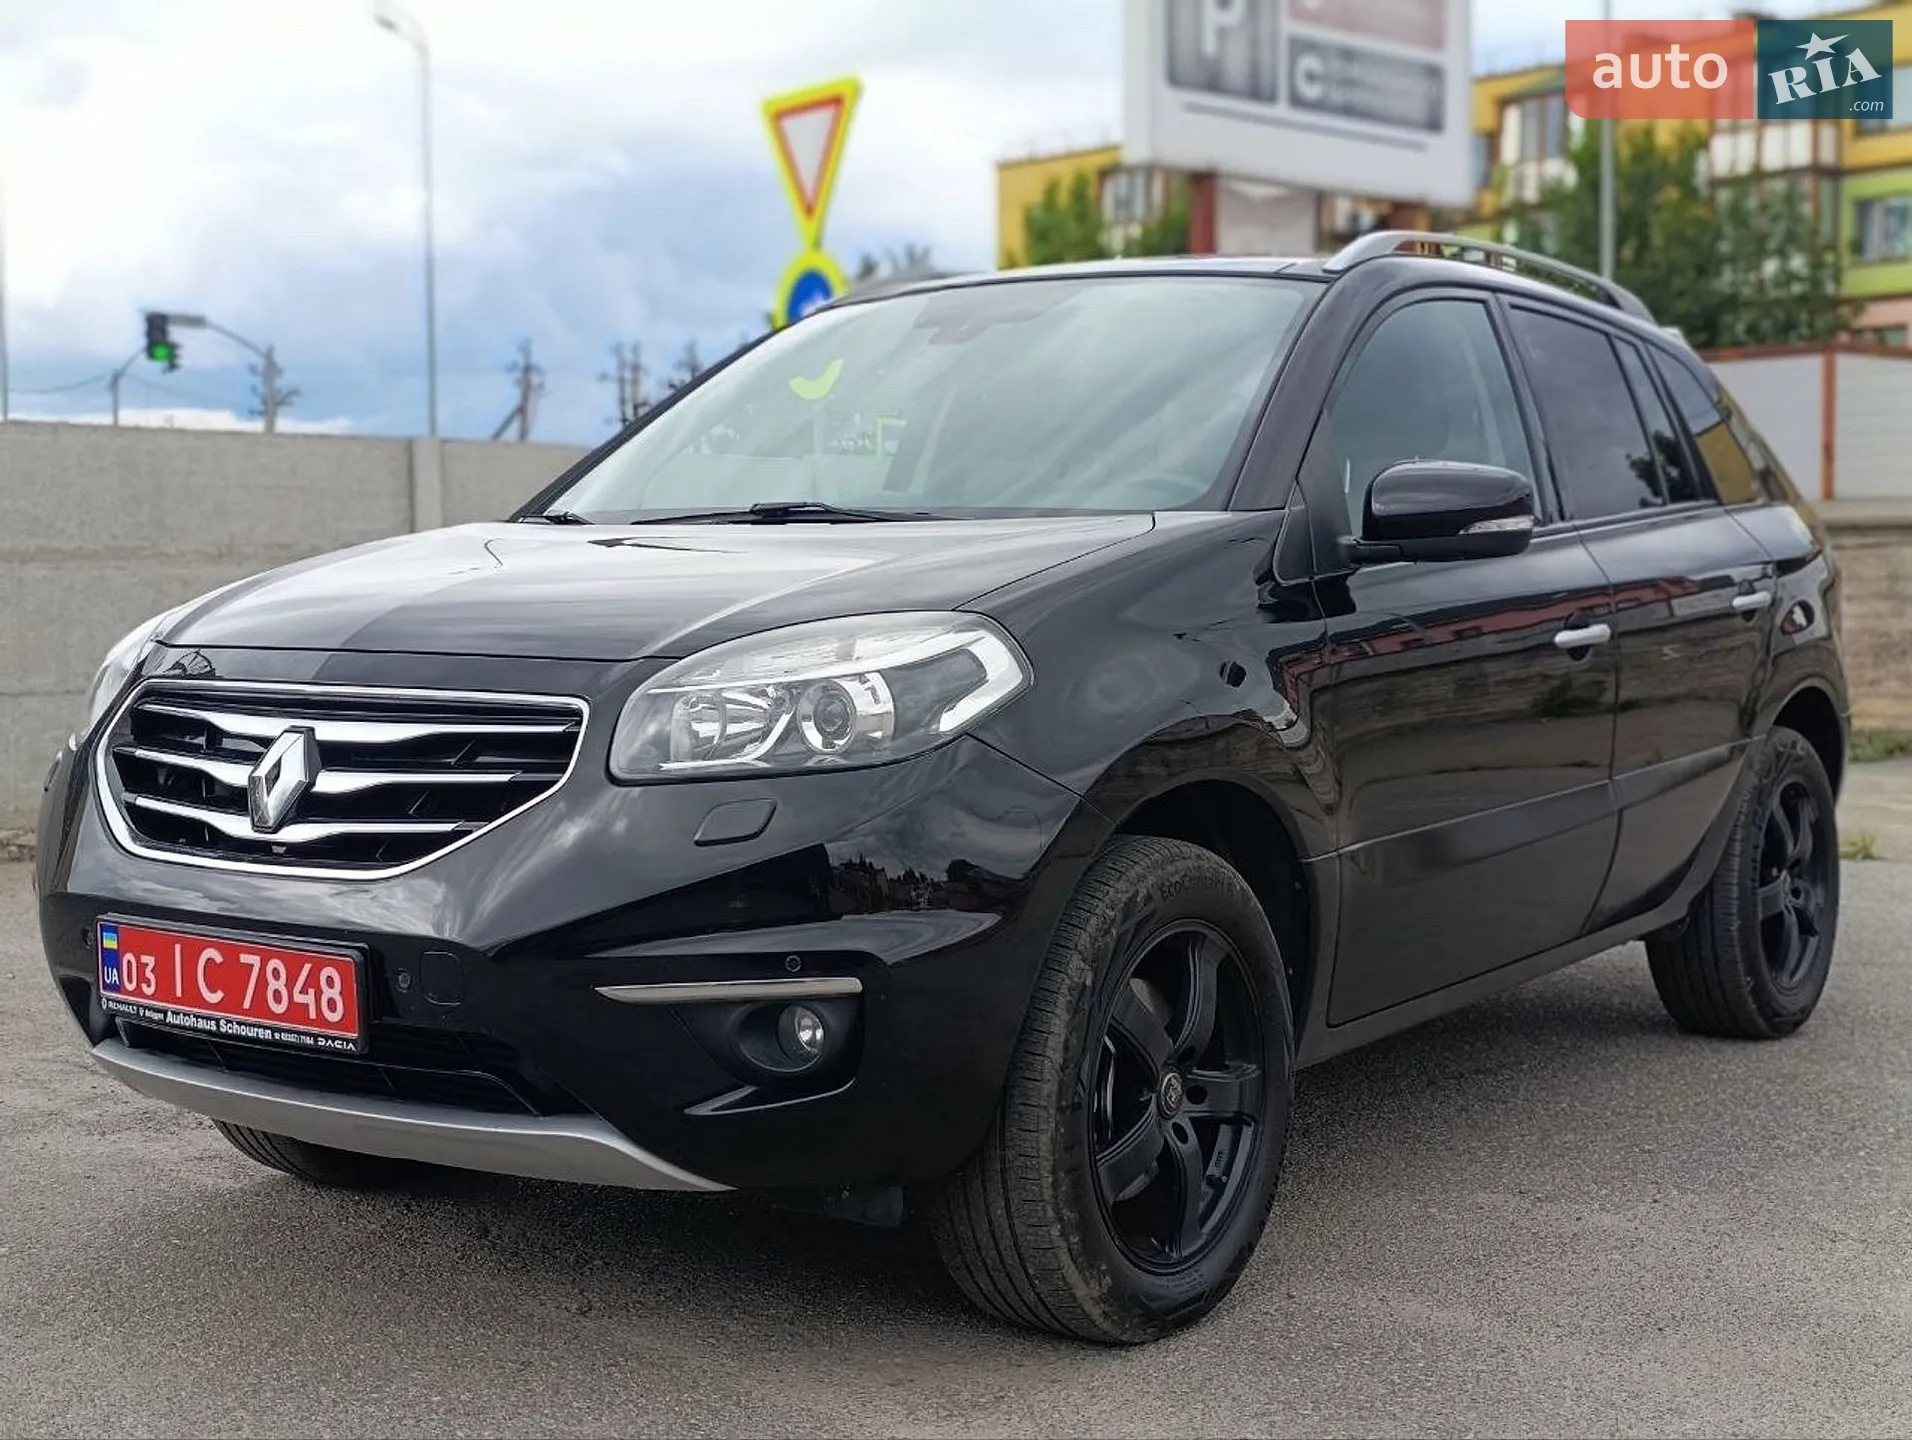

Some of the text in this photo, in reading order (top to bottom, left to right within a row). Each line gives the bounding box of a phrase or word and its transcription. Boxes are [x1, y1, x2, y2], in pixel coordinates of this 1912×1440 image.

[104, 965, 120, 986] UA
[122, 952, 156, 996] 03
[239, 953, 345, 1023] 7848
[165, 1010, 217, 1032] Autohaus
[219, 1018, 272, 1040] Schouren
[317, 1038, 357, 1051] DACIA
